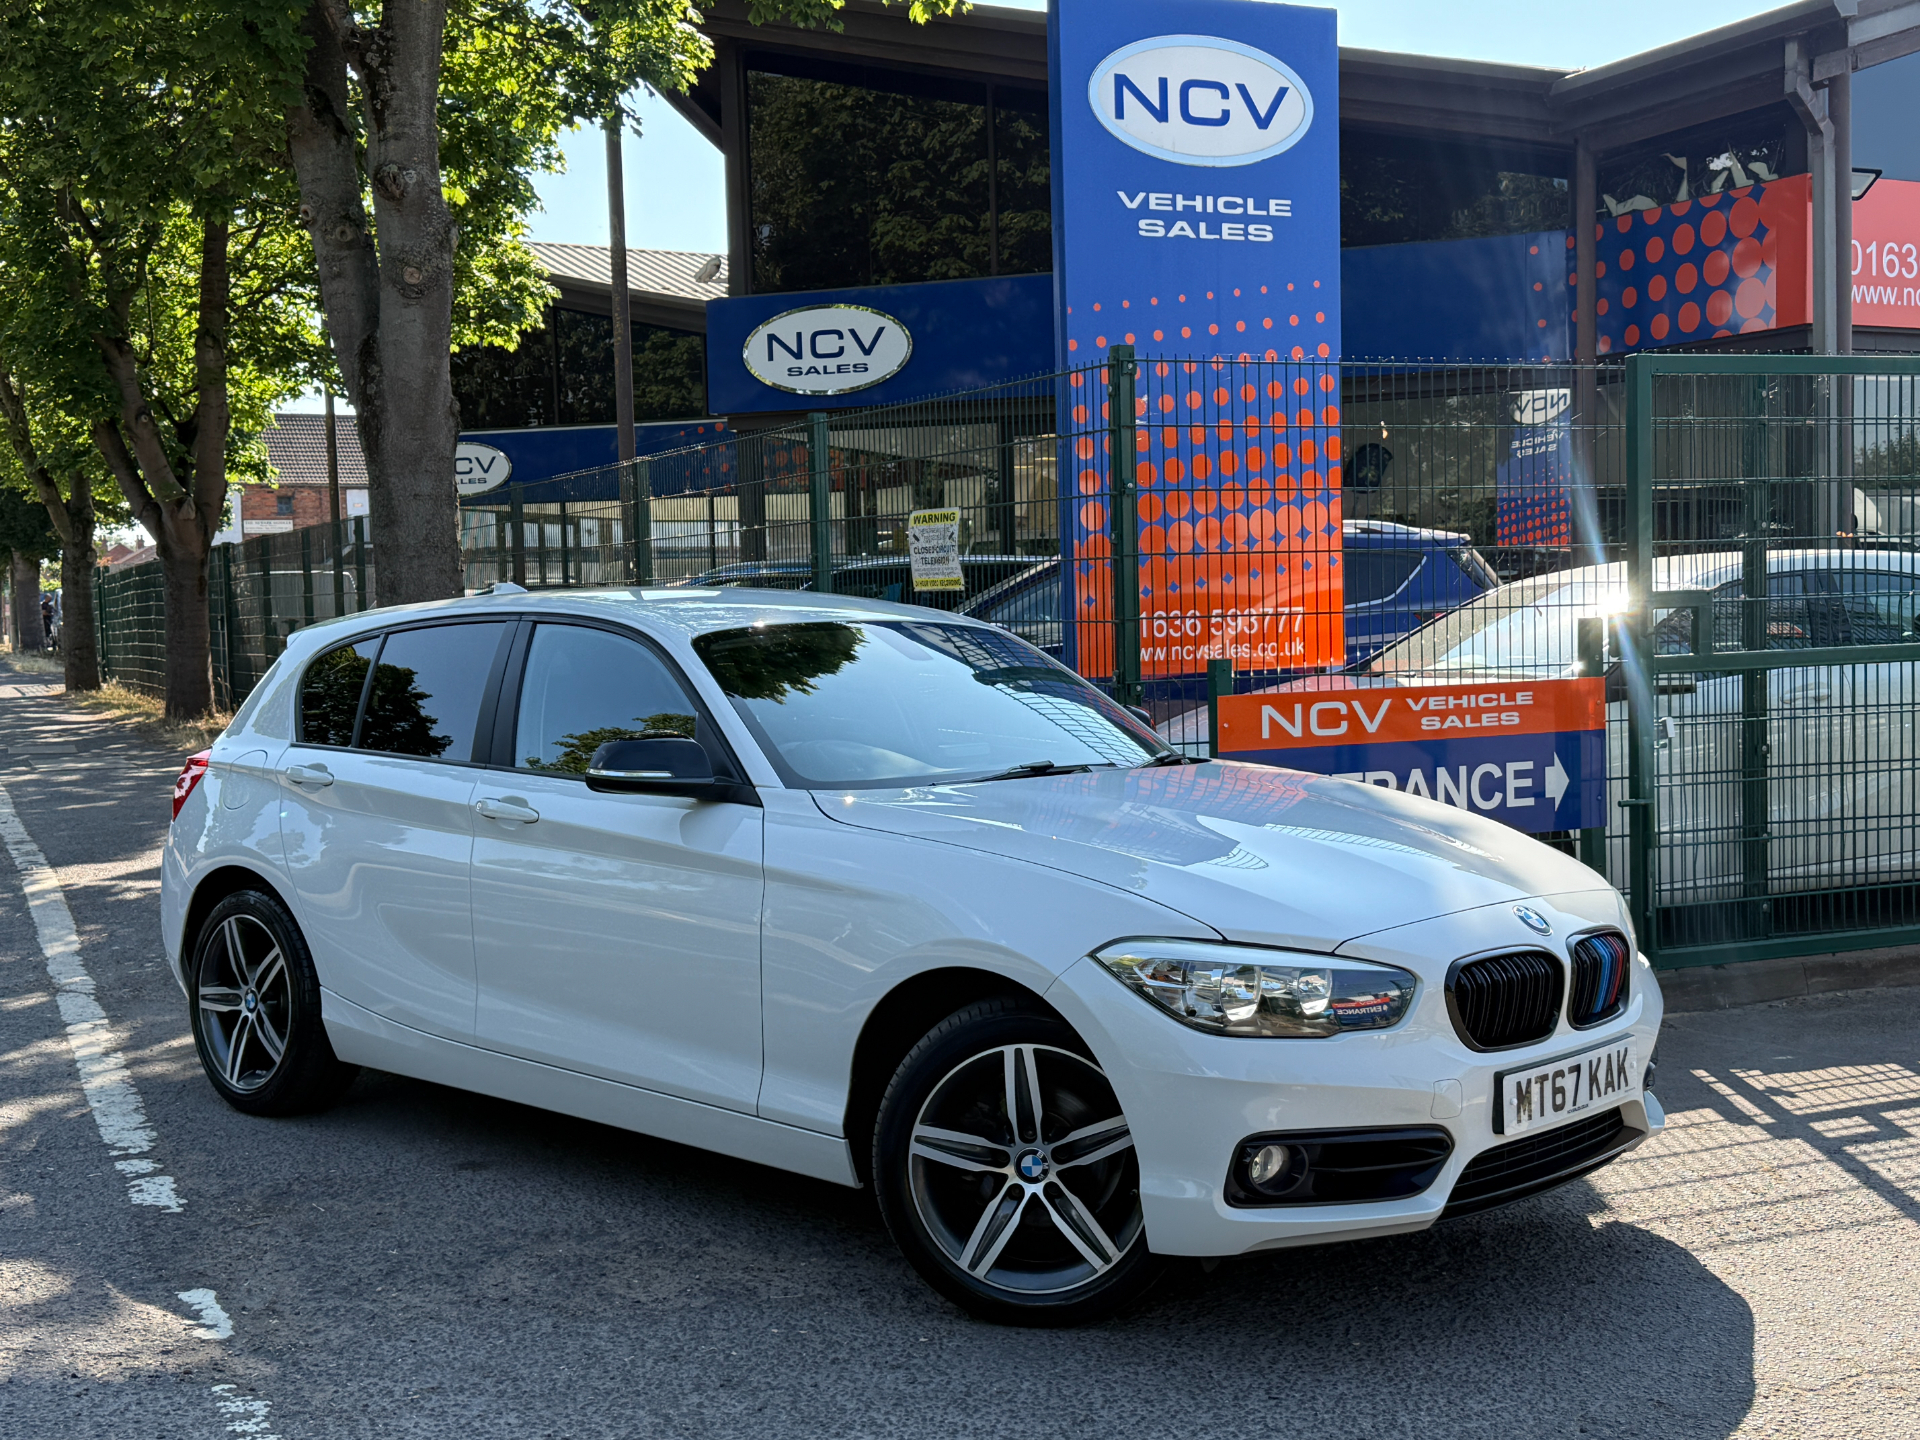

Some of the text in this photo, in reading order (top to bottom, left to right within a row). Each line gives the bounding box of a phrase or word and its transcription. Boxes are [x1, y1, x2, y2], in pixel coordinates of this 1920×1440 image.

[1114, 73, 1289, 130] NCV
[1117, 191, 1292, 217] VEHICLE
[1138, 219, 1274, 242] SALES
[1851, 239, 1920, 279] 0163
[1851, 284, 1920, 307] www.n
[766, 326, 886, 362] NCV
[787, 362, 869, 377] SALES
[455, 456, 496, 475] CV
[458, 477, 487, 485] LES
[913, 512, 956, 525] WARNING
[1140, 607, 1305, 638] 1636 593777
[1140, 637, 1304, 662] ww.ncvsales.co.uk
[1261, 691, 1534, 739] NCV VEHICLE
[1420, 711, 1521, 730] SALES
[1516, 1047, 1629, 1124] MT67 KAK
